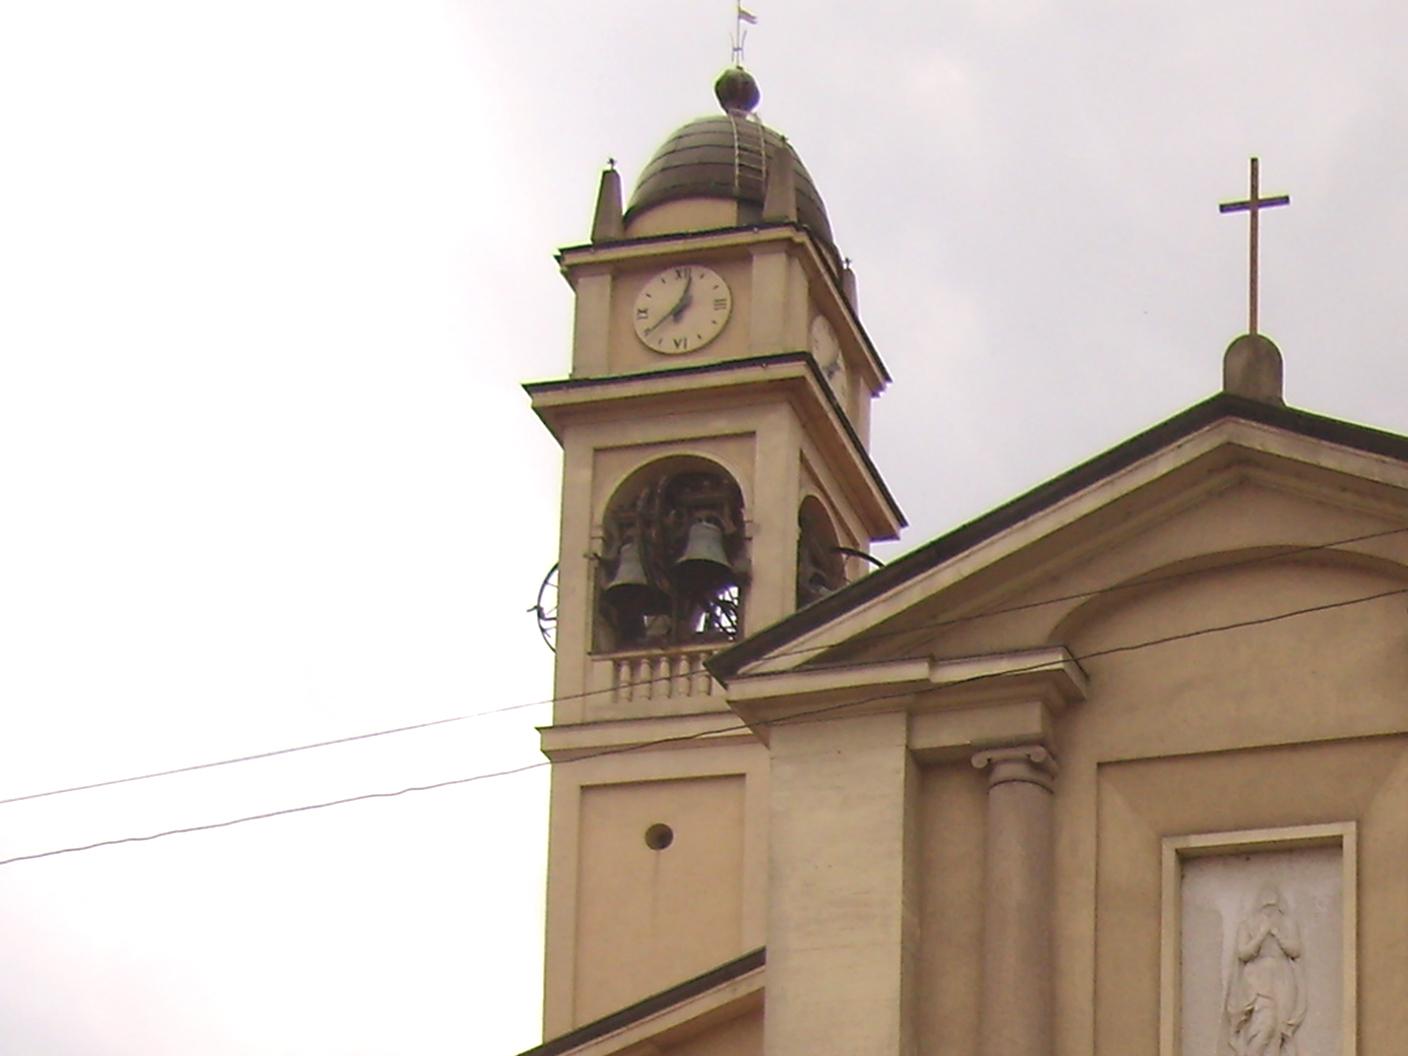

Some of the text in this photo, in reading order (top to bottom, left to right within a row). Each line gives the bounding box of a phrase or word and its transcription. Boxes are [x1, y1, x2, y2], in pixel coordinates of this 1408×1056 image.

[674, 267, 692, 280] XII
[713, 298, 727, 311] III
[672, 337, 688, 350] VI
